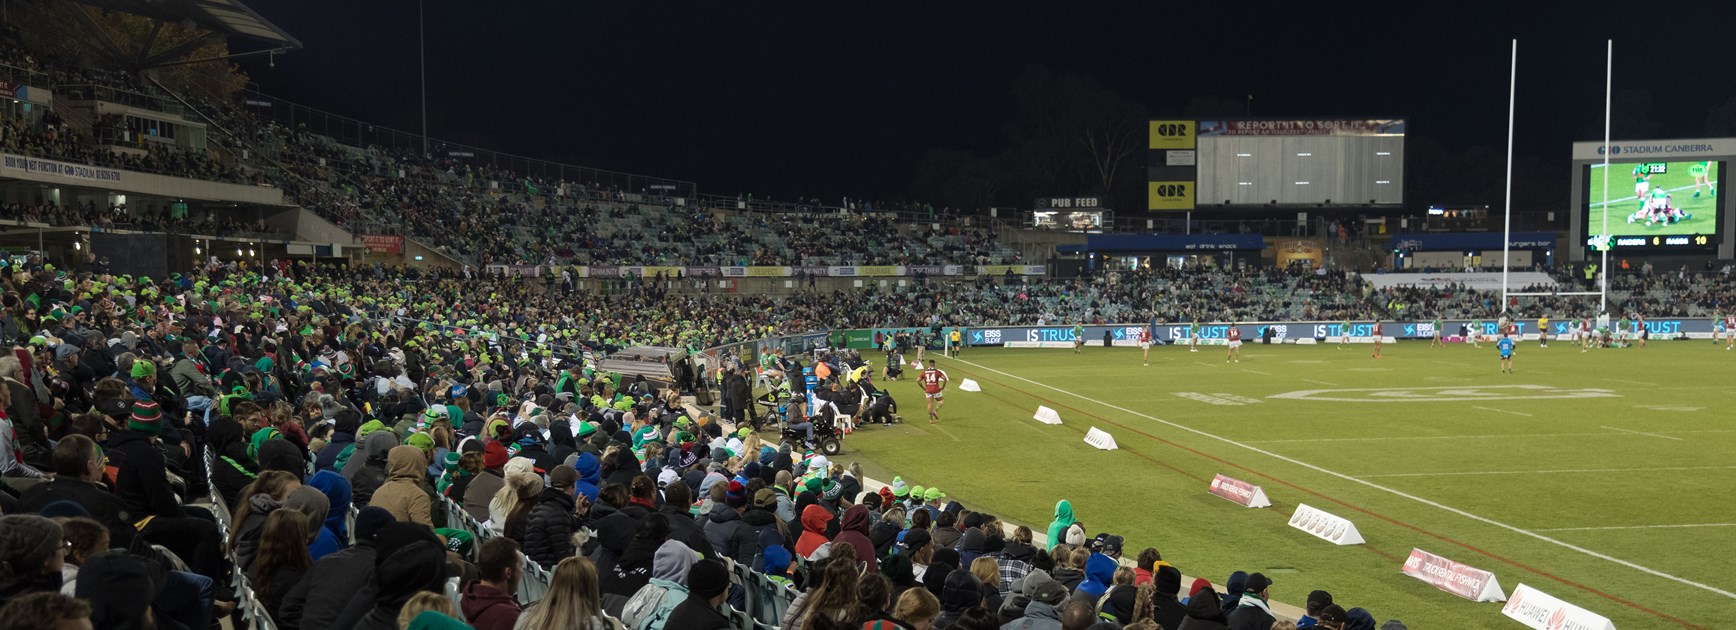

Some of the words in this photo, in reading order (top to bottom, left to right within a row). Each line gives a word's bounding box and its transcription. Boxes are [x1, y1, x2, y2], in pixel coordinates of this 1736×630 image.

[1158, 124, 1186, 136] CBR
[1239, 121, 1281, 129] REPORT
[1286, 121, 1295, 129] IT
[1298, 121, 1314, 129] TO
[1318, 120, 1347, 129] SORT
[1349, 120, 1361, 128] IT
[1623, 146, 1663, 154] STADIUM
[1665, 144, 1713, 153] CANBERRA
[5, 156, 16, 168] BOOK
[38, 161, 57, 174] FUNCTION
[75, 166, 95, 178] STADIUM
[1157, 184, 1186, 197] CBR
[1051, 198, 1071, 207] PUB
[1075, 198, 1098, 207] FEED
[1652, 236, 1660, 246] 6
[1695, 235, 1707, 245] 10
[985, 329, 1002, 338] EISS
[1027, 329, 1039, 342] IS
[1041, 329, 1085, 341] TRUS
[1169, 327, 1181, 339] IS
[1184, 326, 1229, 338] TUST
[1313, 325, 1327, 338] IS
[984, 336, 1001, 344] super
[926, 373, 937, 382] 14
[1423, 561, 1440, 575] TRUCK
[1438, 566, 1456, 581] RENTAL
[1519, 600, 1551, 624] HUAWEI
[1563, 618, 1593, 630] HUA
